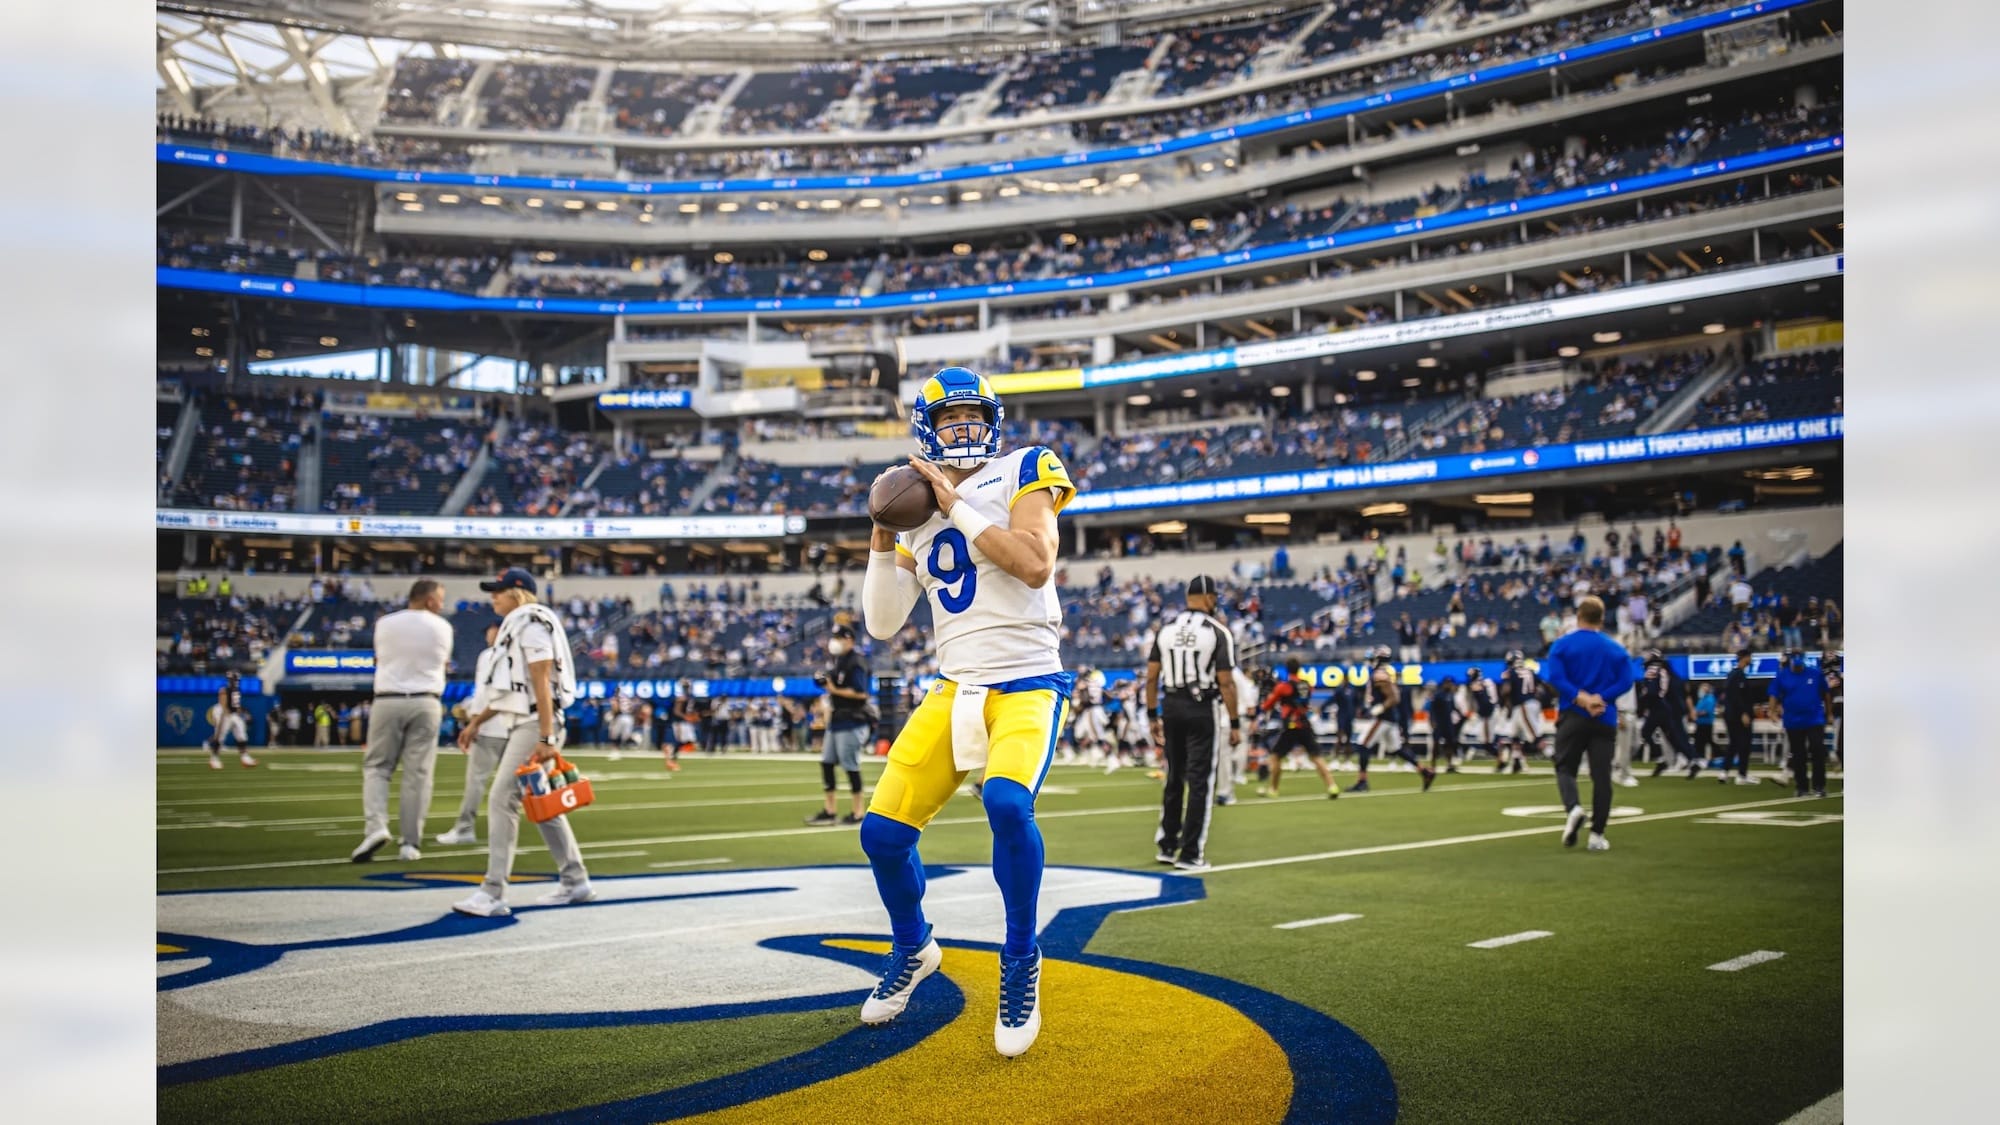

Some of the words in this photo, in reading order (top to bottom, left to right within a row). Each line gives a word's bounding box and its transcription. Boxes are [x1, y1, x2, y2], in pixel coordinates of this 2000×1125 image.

[1575, 442, 1606, 462] TWO
[1647, 427, 1743, 456] TOUCHDOWNS
[1745, 421, 1796, 445] MEANS
[1798, 418, 1828, 439] ONE
[976, 475, 1002, 490] RAMS
[927, 527, 978, 615] 9
[1173, 631, 1198, 648] 38
[575, 681, 606, 699] UR
[560, 789, 578, 808] G
